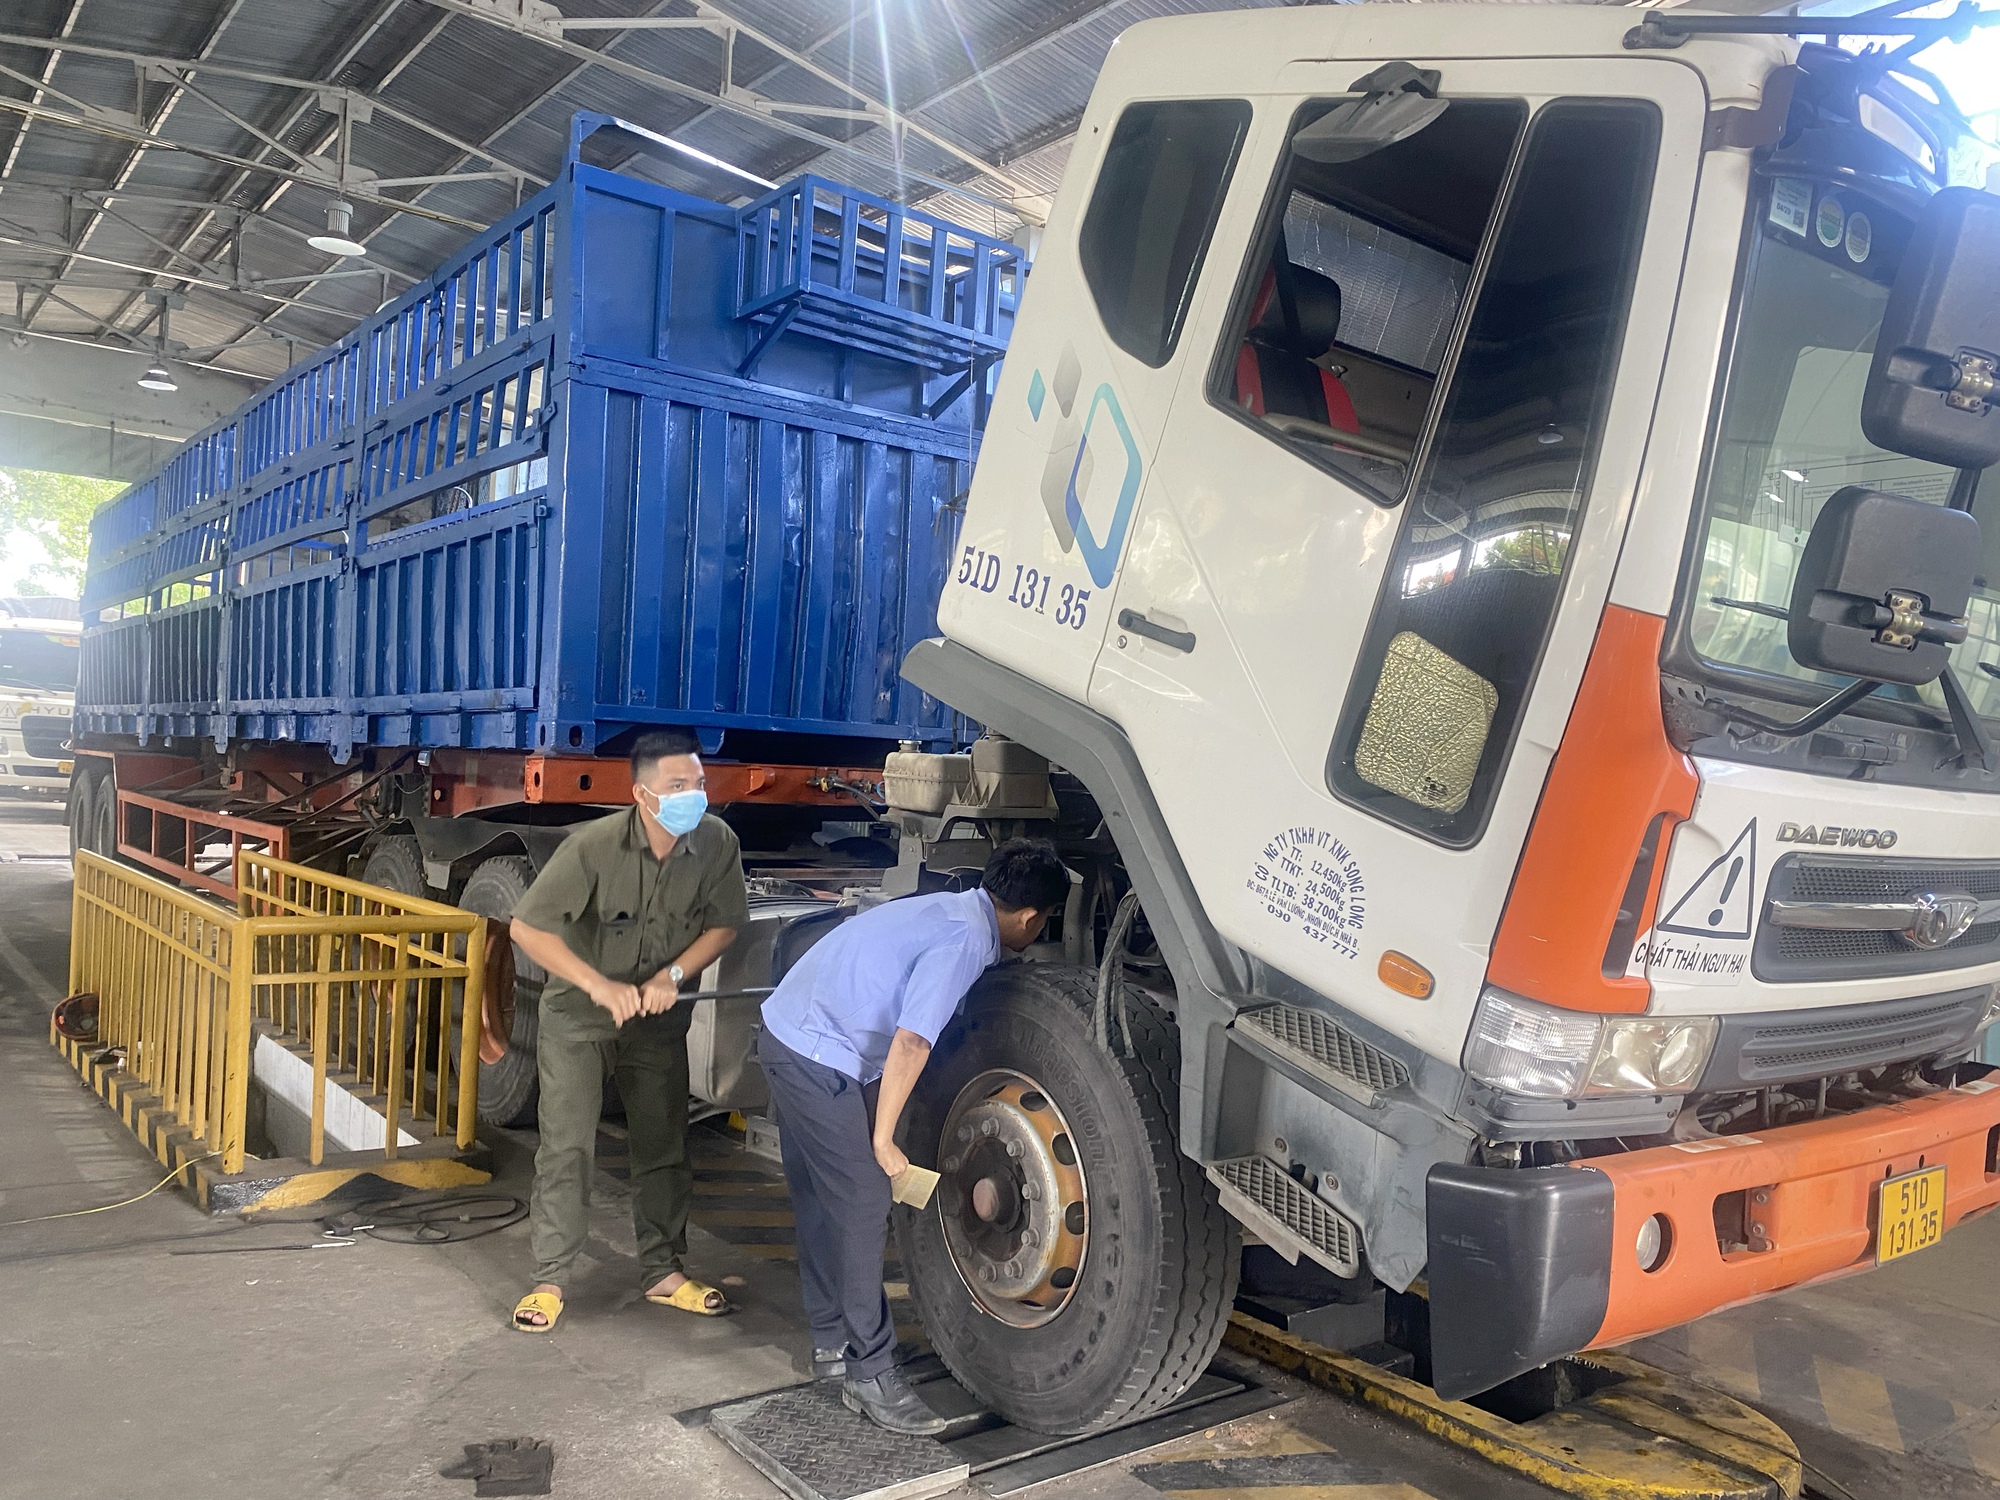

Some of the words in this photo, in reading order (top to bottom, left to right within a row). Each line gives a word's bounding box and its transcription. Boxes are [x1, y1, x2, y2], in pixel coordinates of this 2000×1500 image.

[958, 545, 1001, 593] 51D
[1008, 564, 1051, 615] 131
[1055, 583, 1091, 630] 35
[1274, 832, 1288, 851] TY
[1288, 826, 1315, 845] TNHH
[1317, 831, 1331, 849] VT
[1328, 838, 1352, 865] XNK
[1343, 861, 1365, 893] SONG
[1776, 822, 1898, 849] DAEWOO
[1267, 904, 1291, 923] 090
[1302, 925, 1328, 943] 437
[1332, 940, 1358, 960] 777
[1634, 938, 1674, 968] CHẤT
[1672, 942, 1702, 971] THẢI
[1698, 952, 1731, 974] NGUY
[1726, 953, 1748, 978] HẠI
[1900, 1177, 1929, 1215] 51D
[1889, 1209, 1939, 1257] 131.35
